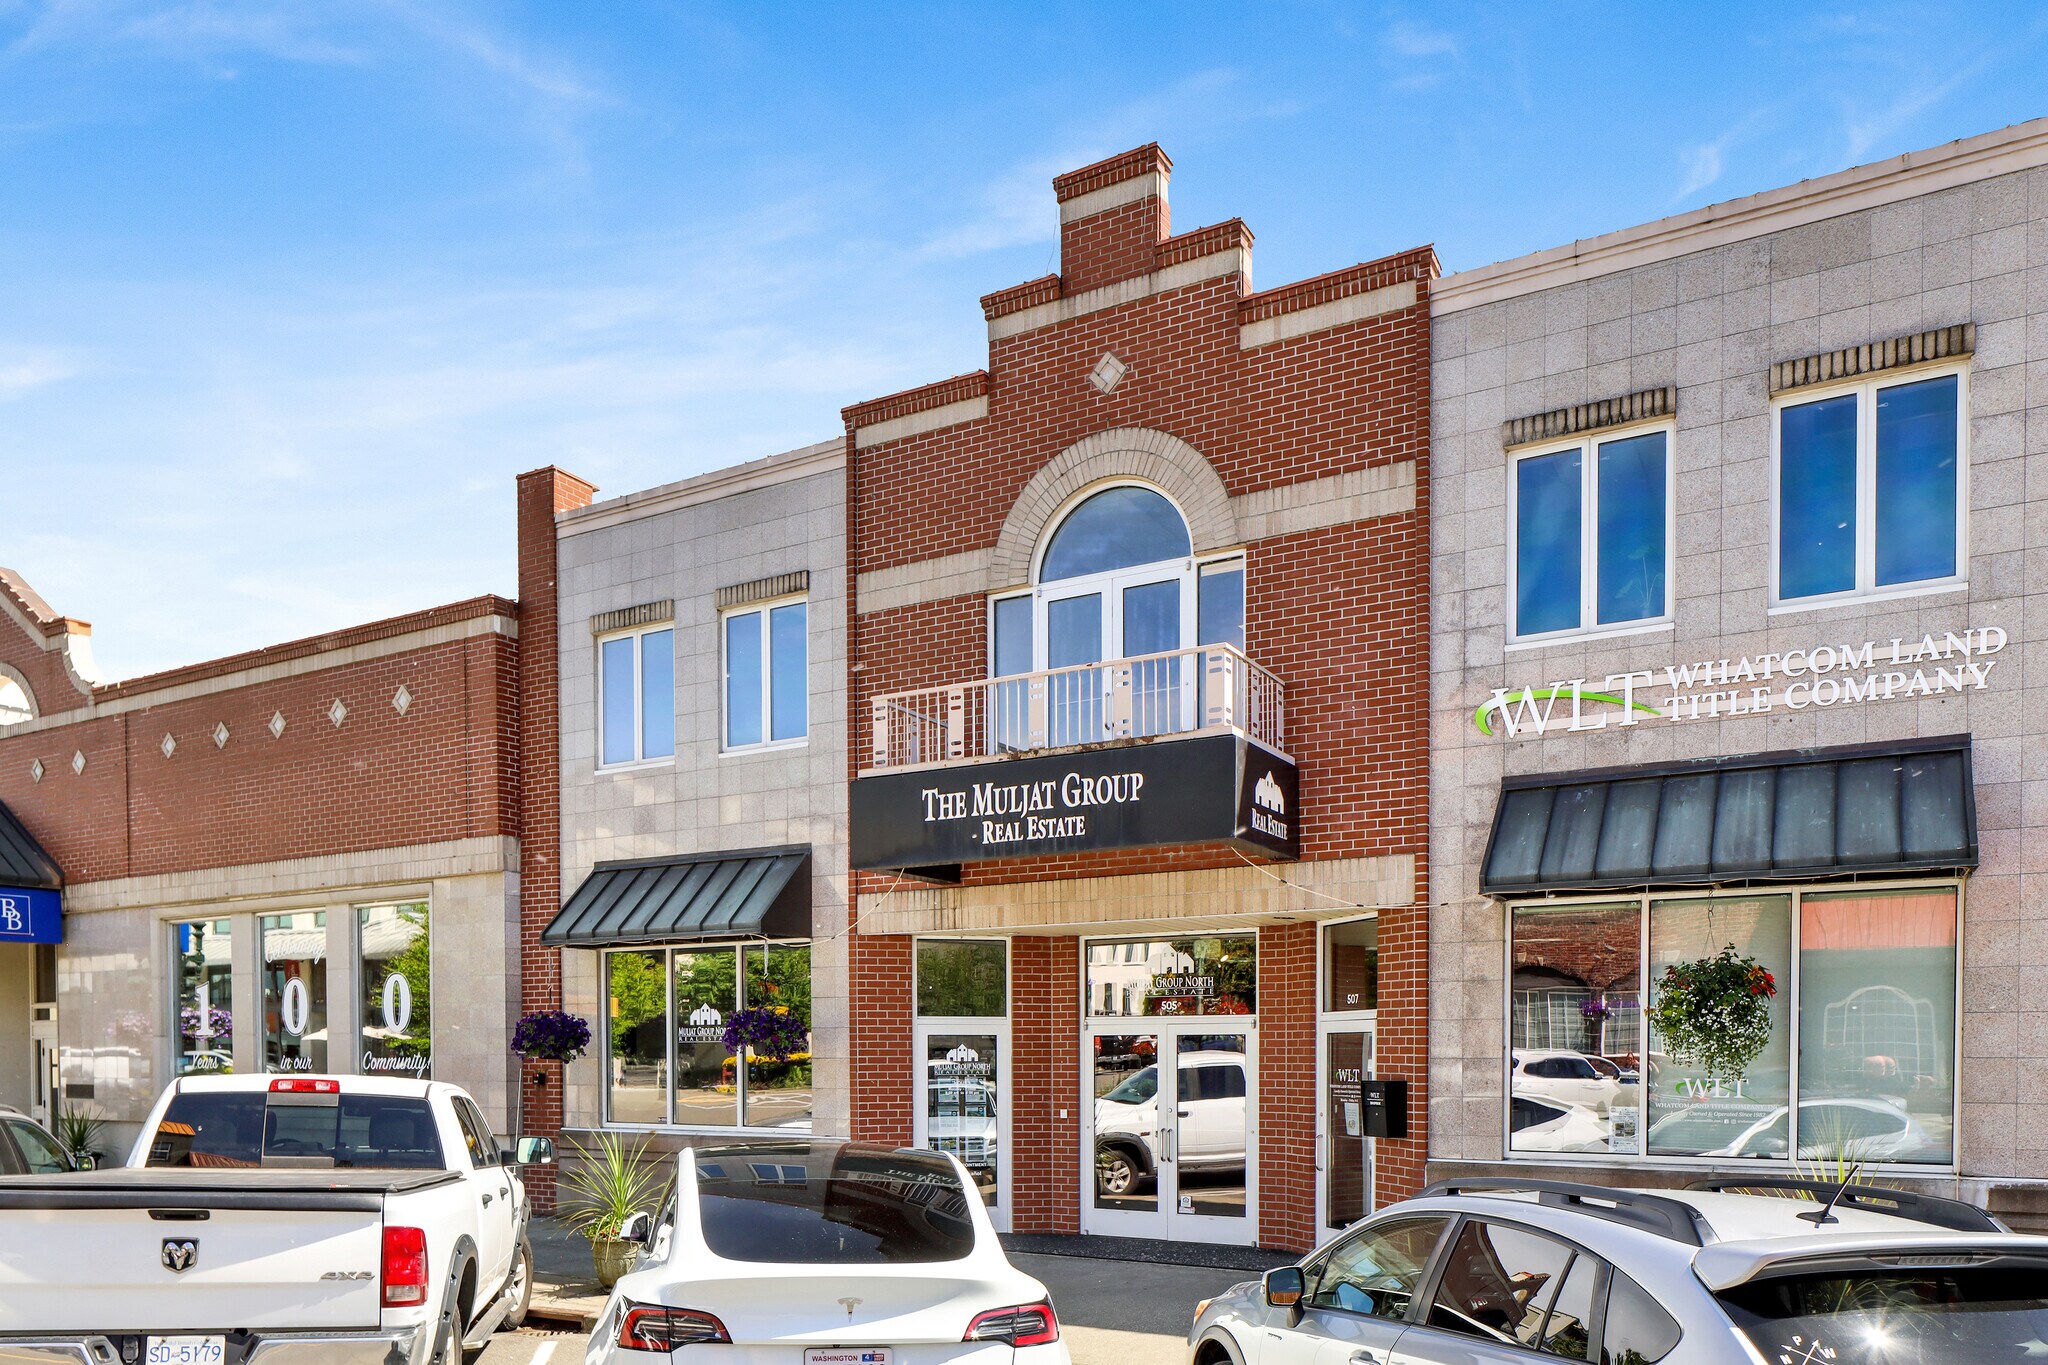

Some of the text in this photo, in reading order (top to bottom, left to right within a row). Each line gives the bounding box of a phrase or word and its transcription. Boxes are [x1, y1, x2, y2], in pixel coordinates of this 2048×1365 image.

[1664, 626, 2008, 690] WHATCOM LAND
[1664, 661, 1996, 721] TITLE COMPANY
[1490, 670, 1653, 739] WLT
[922, 772, 1144, 821] THE MULJAT GROUP
[982, 815, 1086, 845] REAL ESTATE
[1251, 807, 1288, 841] REAL ESTATE
[265, 938, 325, 965] Celebrating
[1155, 976, 1183, 988] GROUP
[1185, 975, 1214, 987] NORTH
[1126, 988, 1214, 997] RAL ESTATE
[1347, 994, 1359, 1005] 507
[1161, 1001, 1178, 1011] 505
[697, 1027, 715, 1036] GROUP
[191, 1052, 219, 1070] Years
[280, 1054, 292, 1070] in
[293, 1056, 313, 1070] our
[1338, 1068, 1360, 1082] WLT
[1683, 1078, 1749, 1099] WLT
